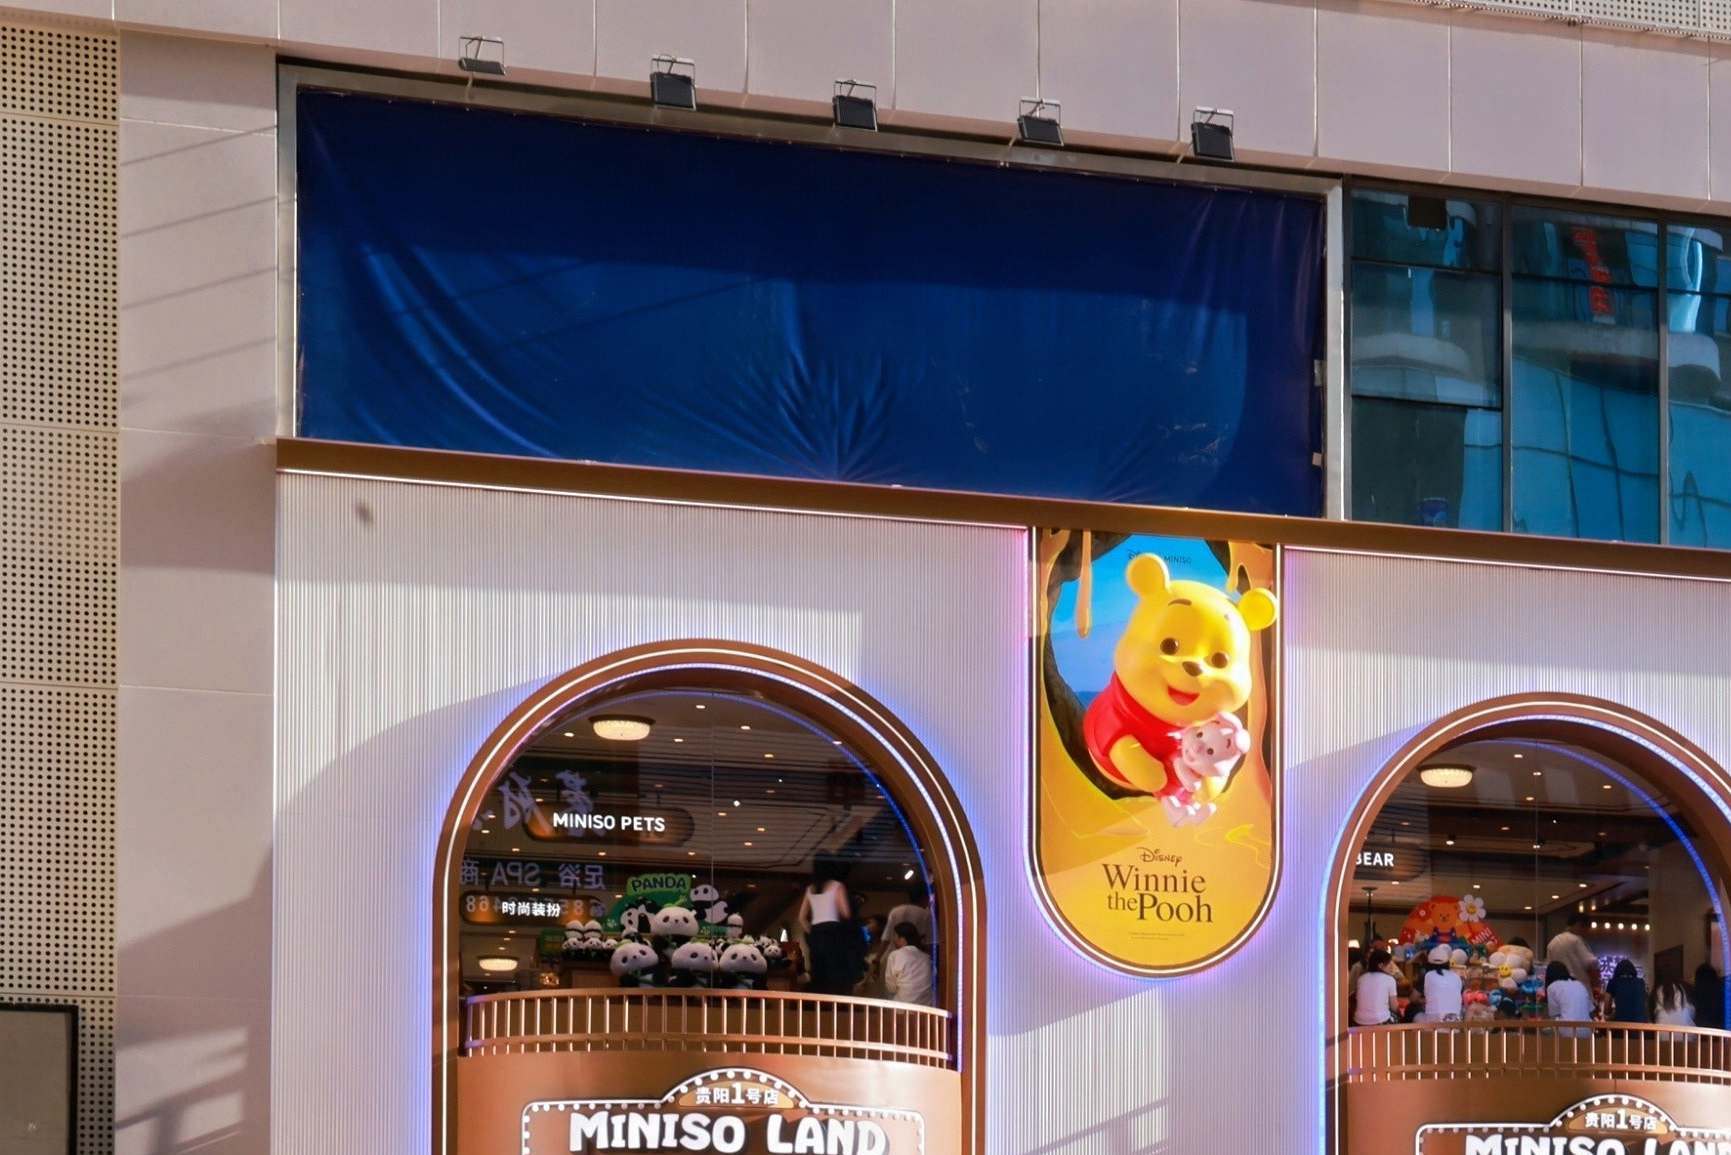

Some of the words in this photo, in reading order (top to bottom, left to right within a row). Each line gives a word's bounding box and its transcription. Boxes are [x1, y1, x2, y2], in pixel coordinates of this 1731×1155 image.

[553, 813, 615, 830] MINISO
[621, 816, 665, 832] PETS
[631, 875, 687, 892] PANDA
[1102, 863, 1207, 893] Winnie
[501, 901, 560, 917] 时尚装扮
[1107, 891, 1138, 911] the
[1138, 893, 1213, 923] Pooh
[695, 1082, 779, 1105] 贵阳1号店
[1585, 1108, 1658, 1131] 贵阳1号店
[569, 1111, 746, 1154] MINISO
